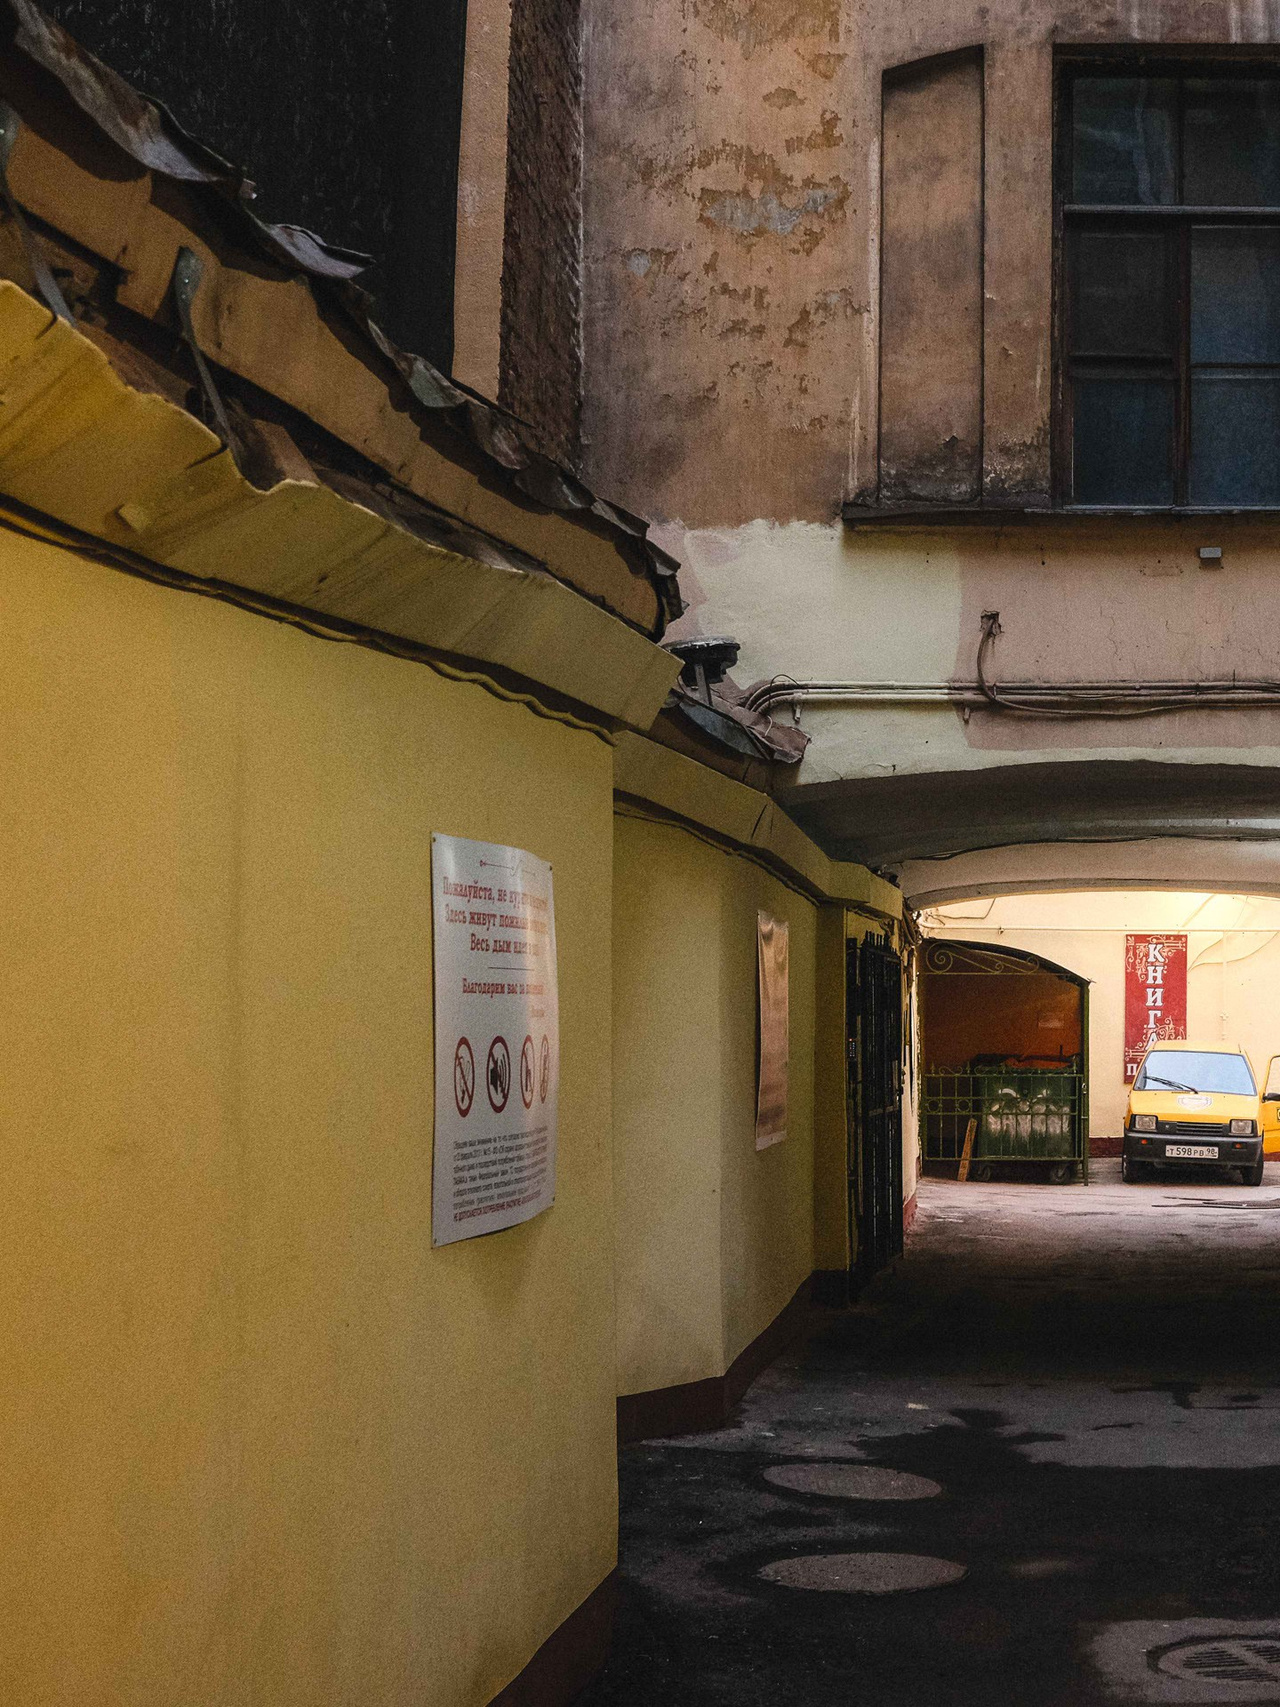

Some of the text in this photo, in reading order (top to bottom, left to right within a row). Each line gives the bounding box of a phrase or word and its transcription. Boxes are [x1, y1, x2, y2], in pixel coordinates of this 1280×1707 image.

[498, 889, 507, 902] не
[469, 911, 497, 931] живут
[470, 932, 490, 952] Весь
[492, 939, 512, 954] дым
[463, 978, 506, 998] Благодарим
